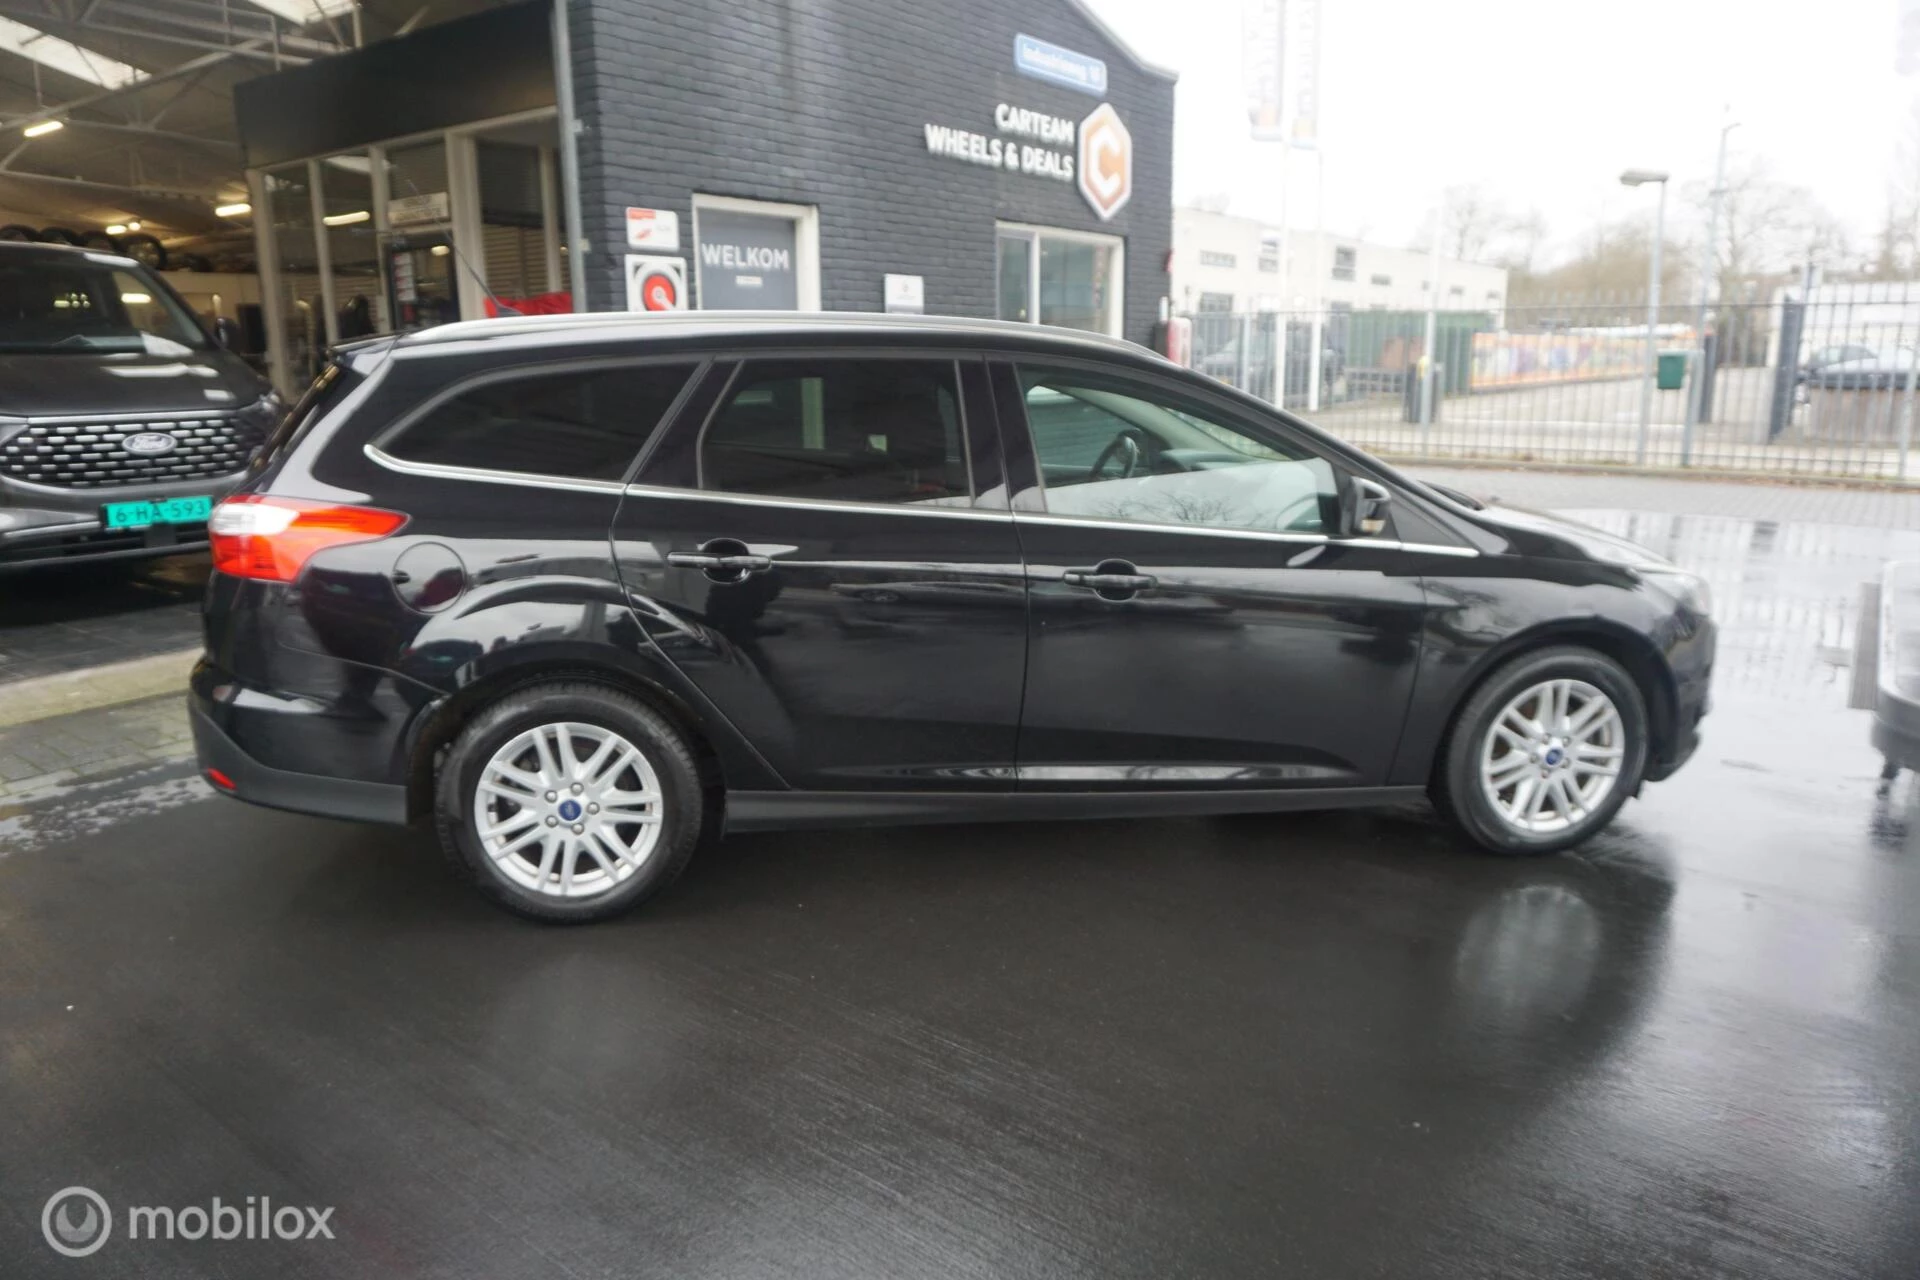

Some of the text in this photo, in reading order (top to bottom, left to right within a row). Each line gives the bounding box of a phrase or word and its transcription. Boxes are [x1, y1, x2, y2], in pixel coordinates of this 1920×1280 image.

[995, 103, 1074, 144] CARTEAM
[924, 123, 1074, 181] WHEELS & DEALS
[702, 243, 790, 270] WELKOM
